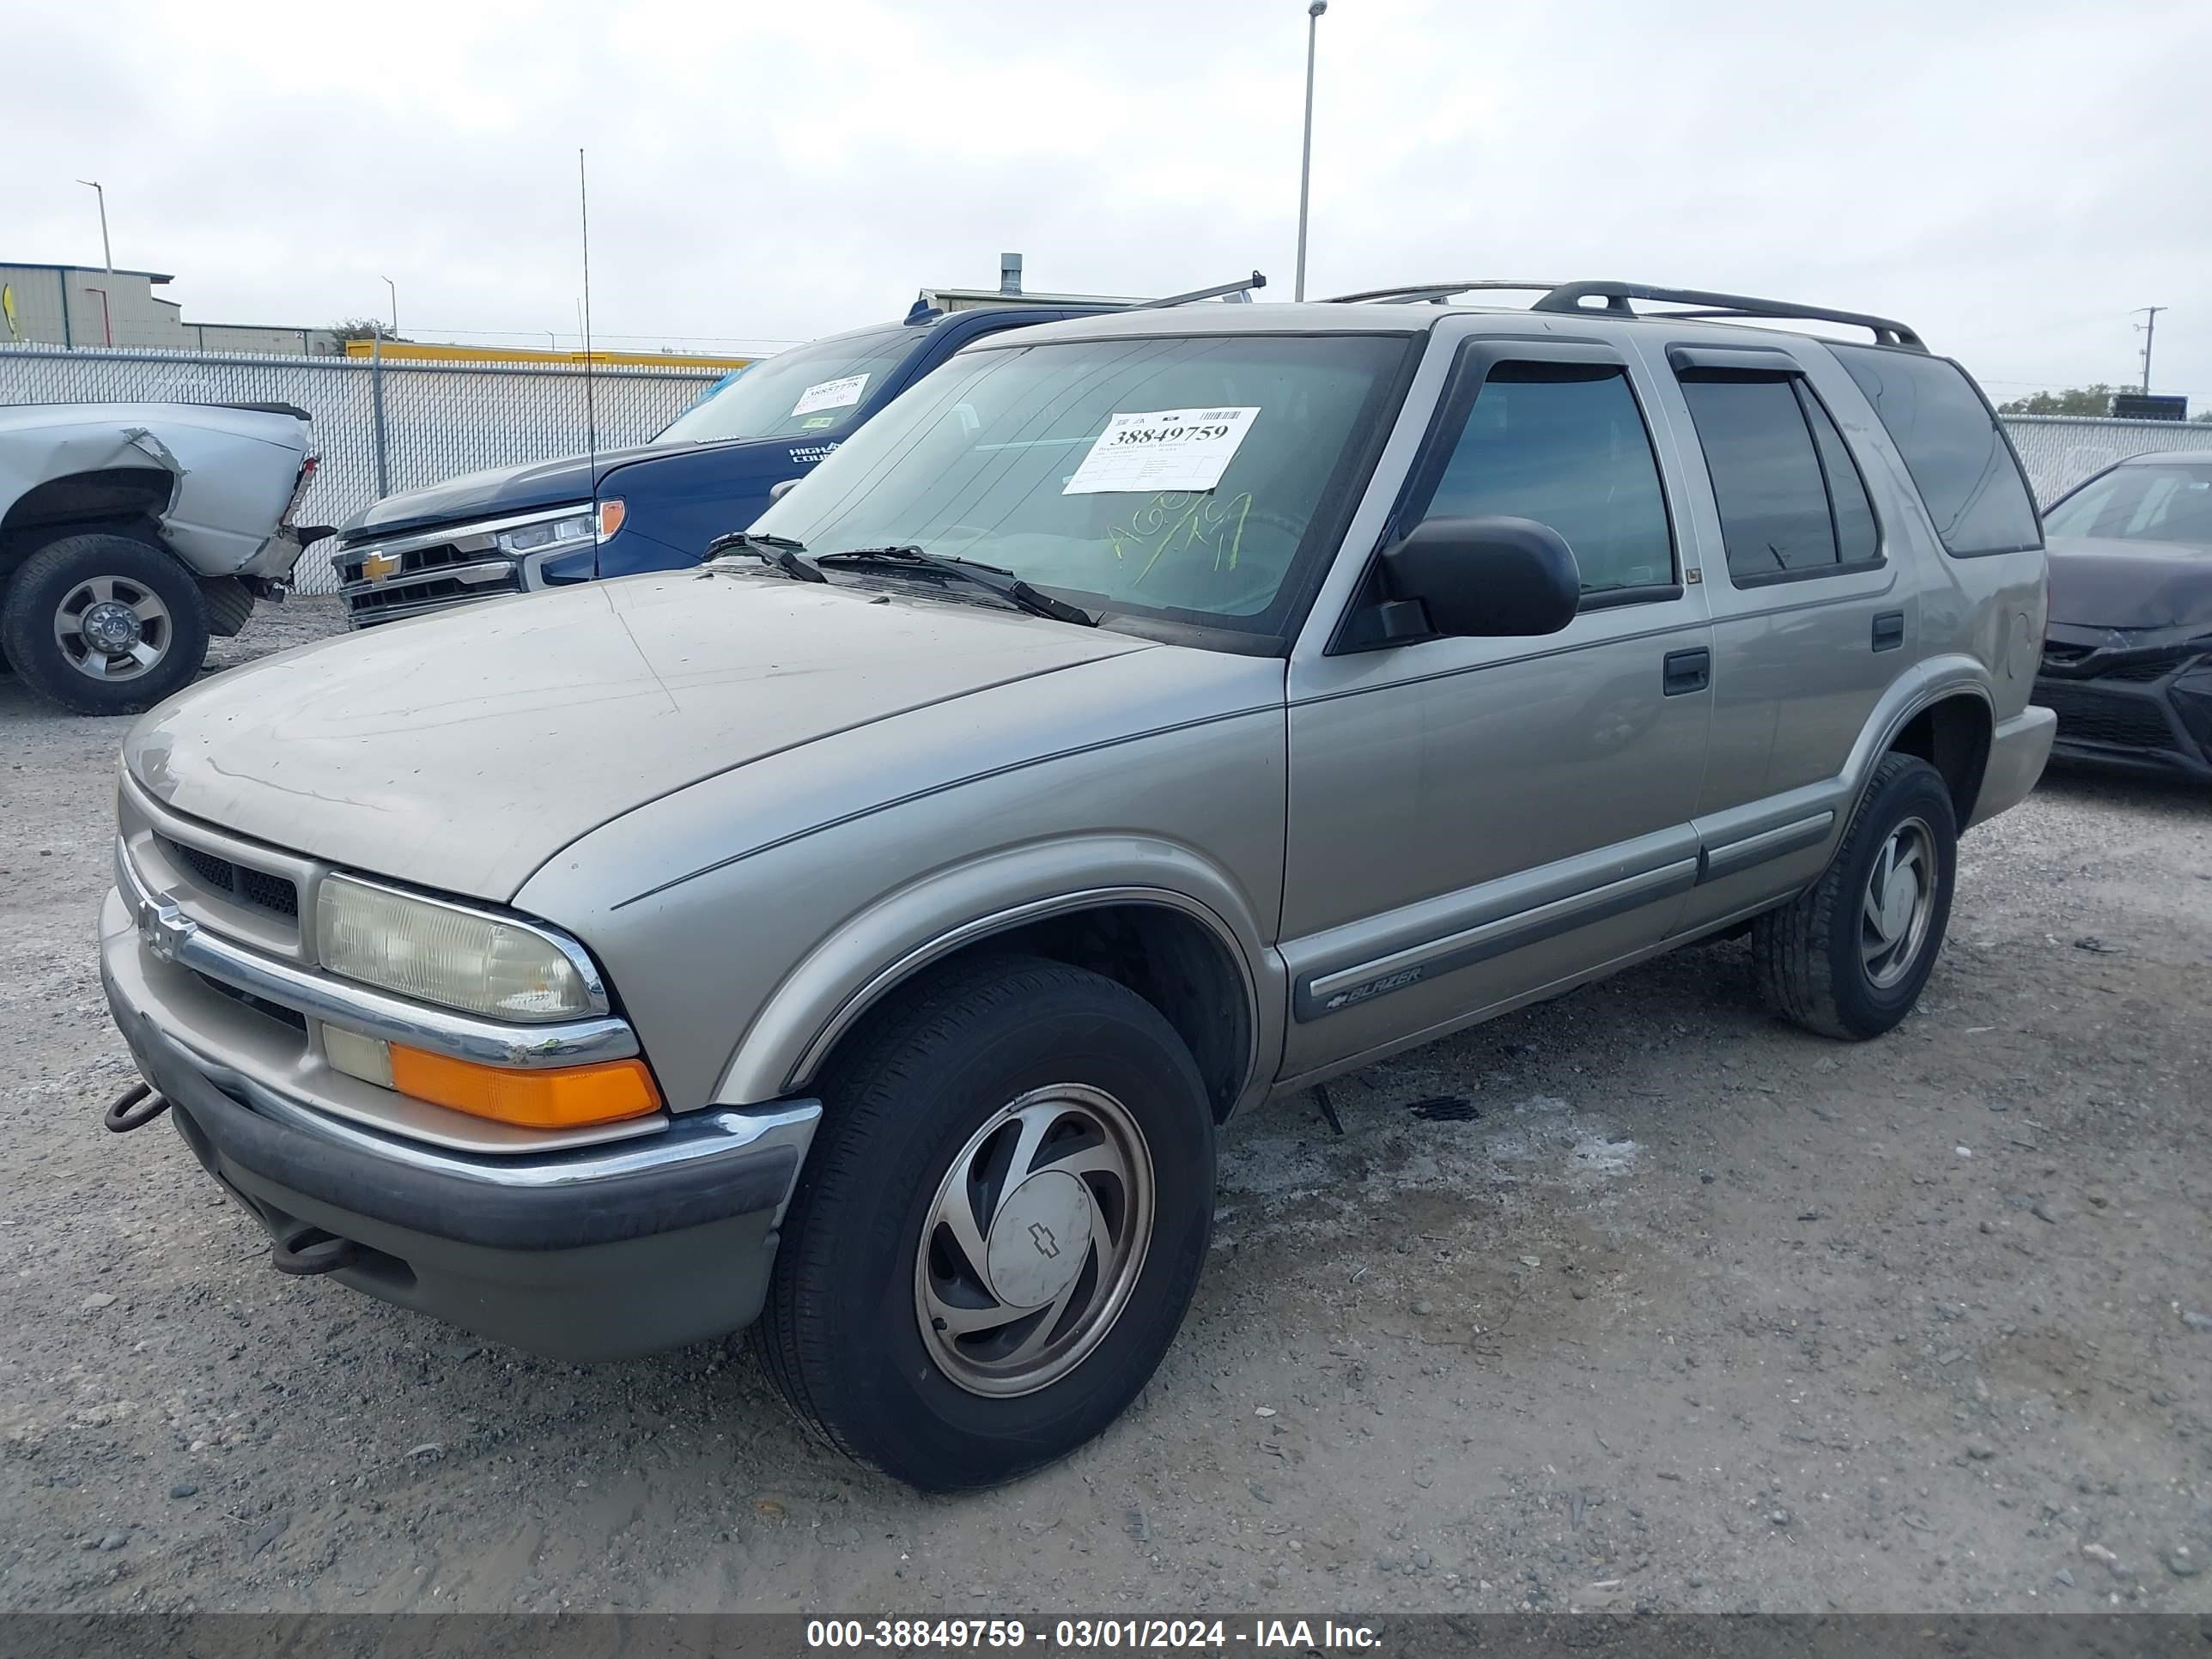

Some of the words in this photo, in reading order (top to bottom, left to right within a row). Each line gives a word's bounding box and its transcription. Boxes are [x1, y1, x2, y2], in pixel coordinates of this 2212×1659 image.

[1109, 424, 1229, 446] 38849759
[789, 447, 826, 456] HIGH
[1346, 967, 1423, 1003] BLAZER
